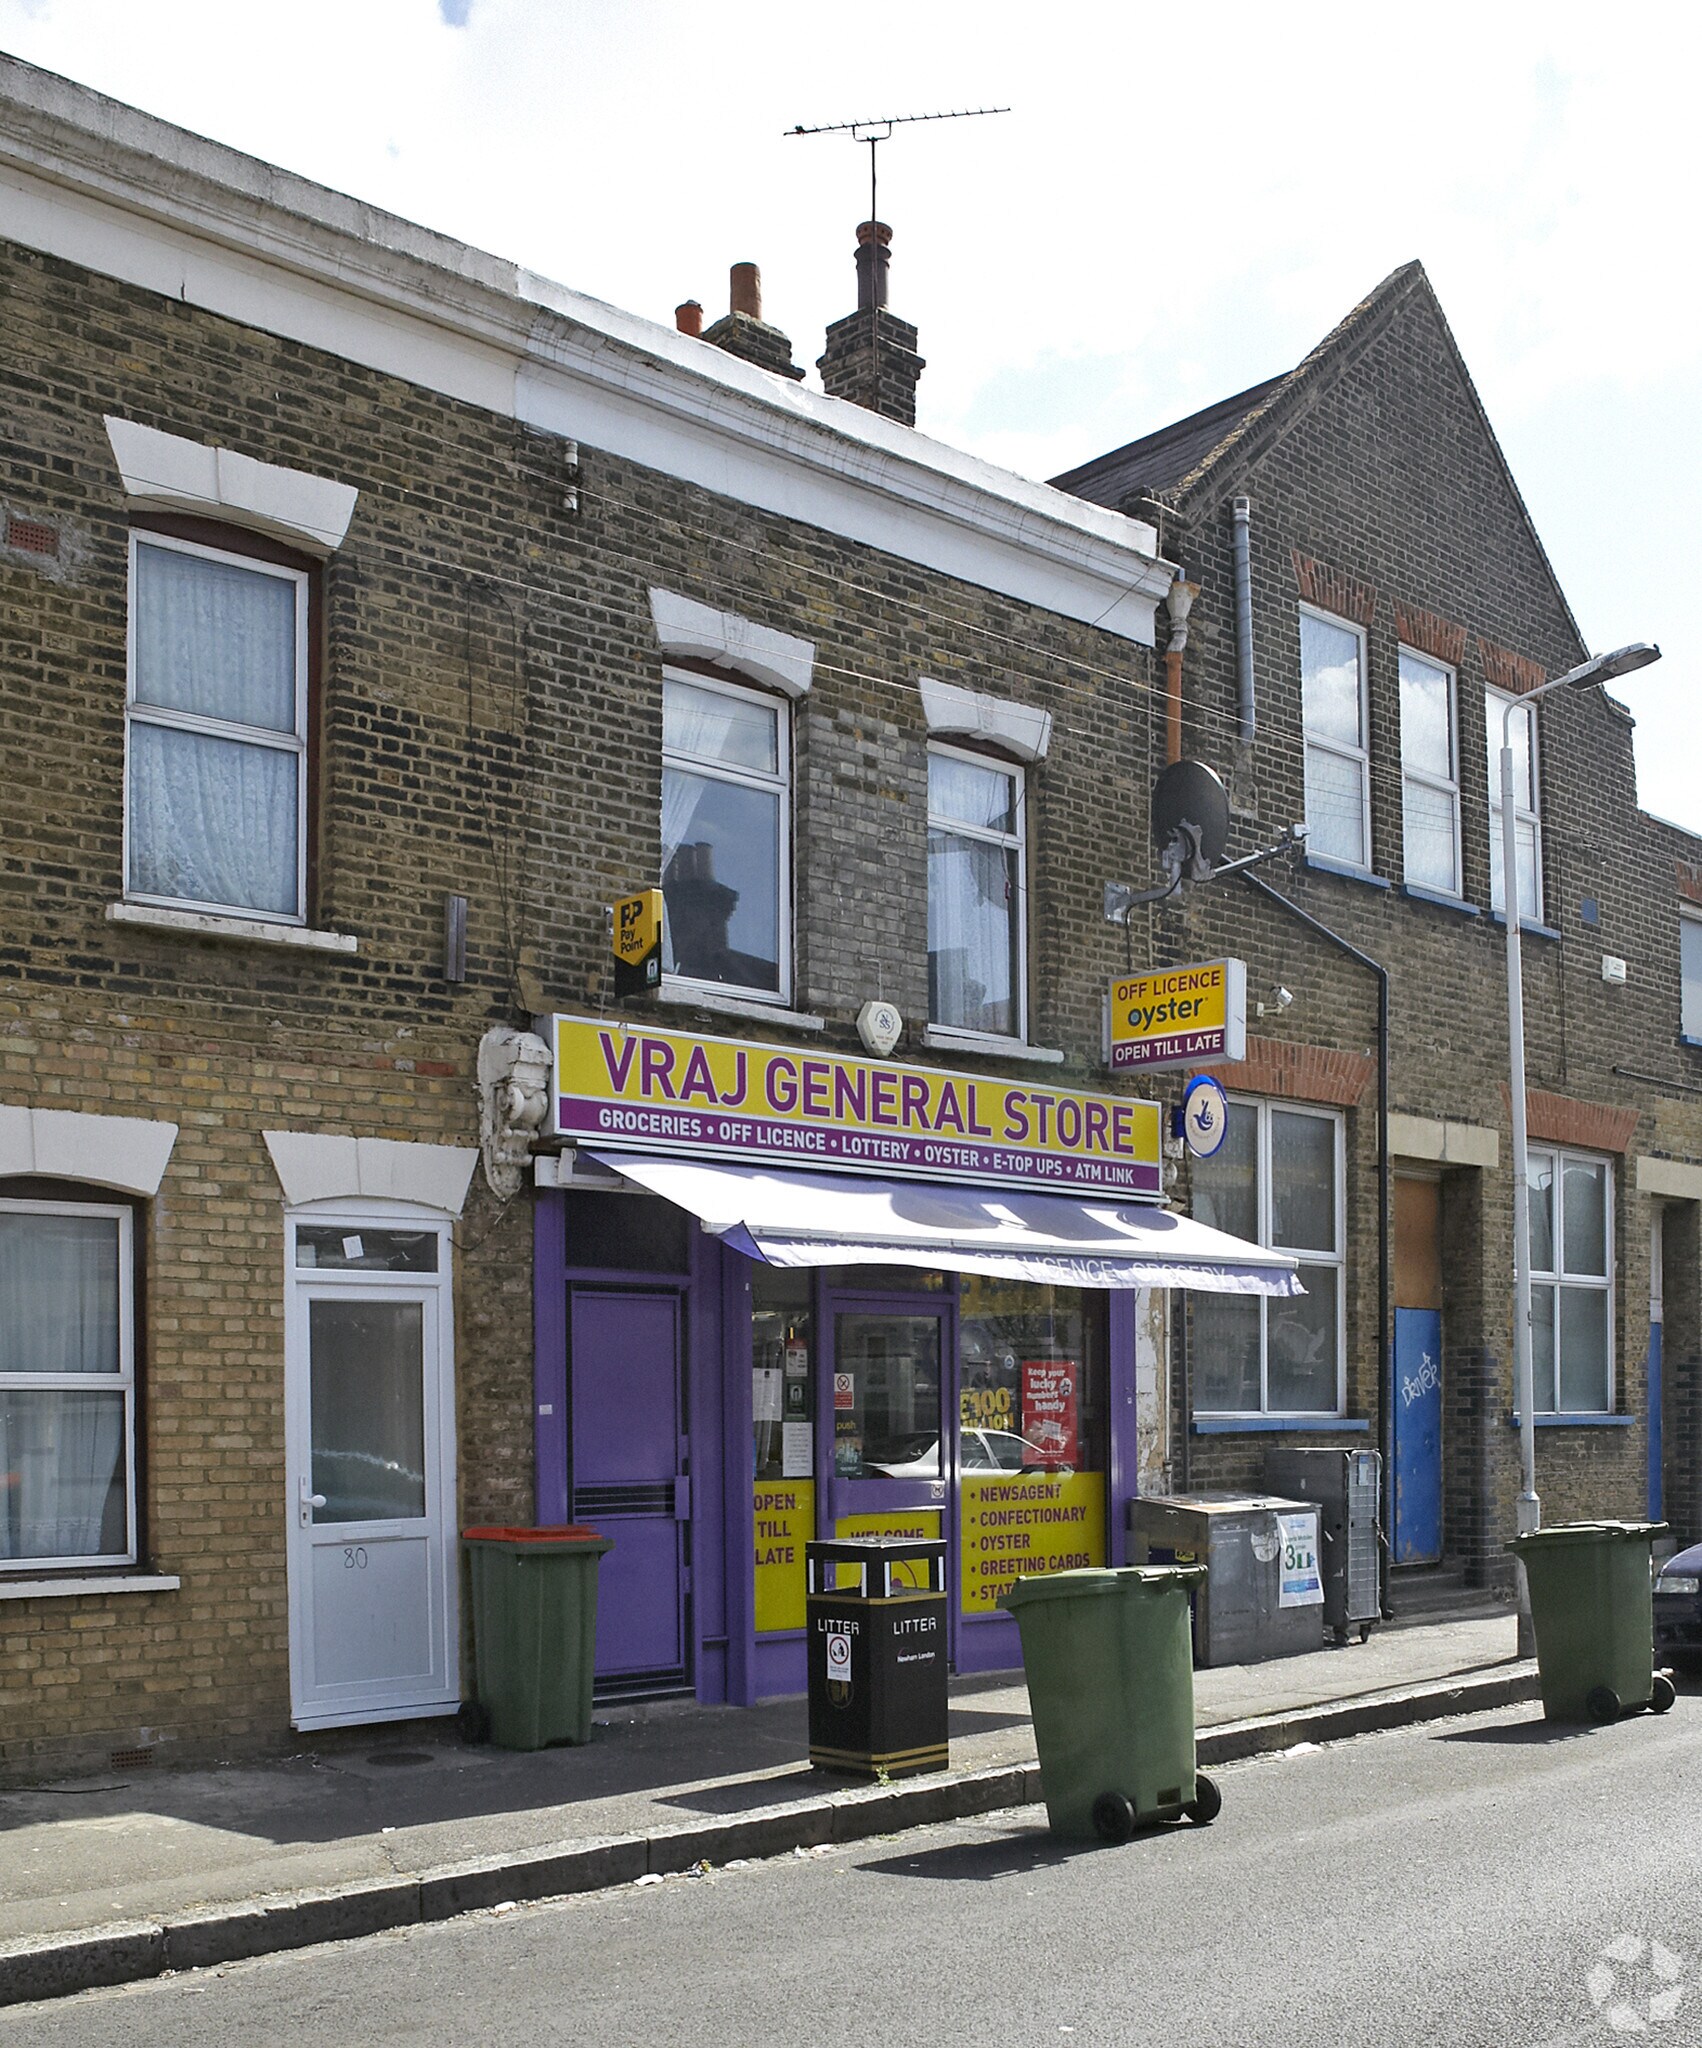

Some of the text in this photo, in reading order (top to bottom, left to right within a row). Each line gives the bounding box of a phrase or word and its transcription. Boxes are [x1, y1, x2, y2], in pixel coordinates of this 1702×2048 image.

[621, 929, 635, 941] Pay
[621, 938, 643, 954] Point
[1118, 970, 1221, 1001] OFF LICENCE
[1128, 997, 1203, 1031] oyster
[1115, 1033, 1221, 1062] OPEN TILL LATE
[598, 1031, 1135, 1155] VRAJ GENERAL STORE
[599, 1108, 1134, 1185] GROCERIES OFF LICENCE LOTTERY OYSTER E-TOP UPS ATM LINK
[1022, 1256, 1117, 1283] ENCE
[1027, 1368, 1066, 1378] Keep your
[1030, 1379, 1056, 1390] lucky
[1035, 1400, 1065, 1412] handy
[836, 1420, 856, 1431] push
[754, 1493, 796, 1511] OPEN
[980, 1484, 1062, 1502] NEWSAGENT
[980, 1506, 1087, 1527] CONFECTIONARY
[757, 1520, 791, 1538] TILL
[980, 1533, 1031, 1551] OYSTER
[343, 1547, 368, 1569] 80
[755, 1547, 795, 1565] LATE
[980, 1553, 1090, 1576] GREETING CARDS
[817, 1618, 860, 1635] LITTER
[893, 1617, 937, 1635] LITTER
